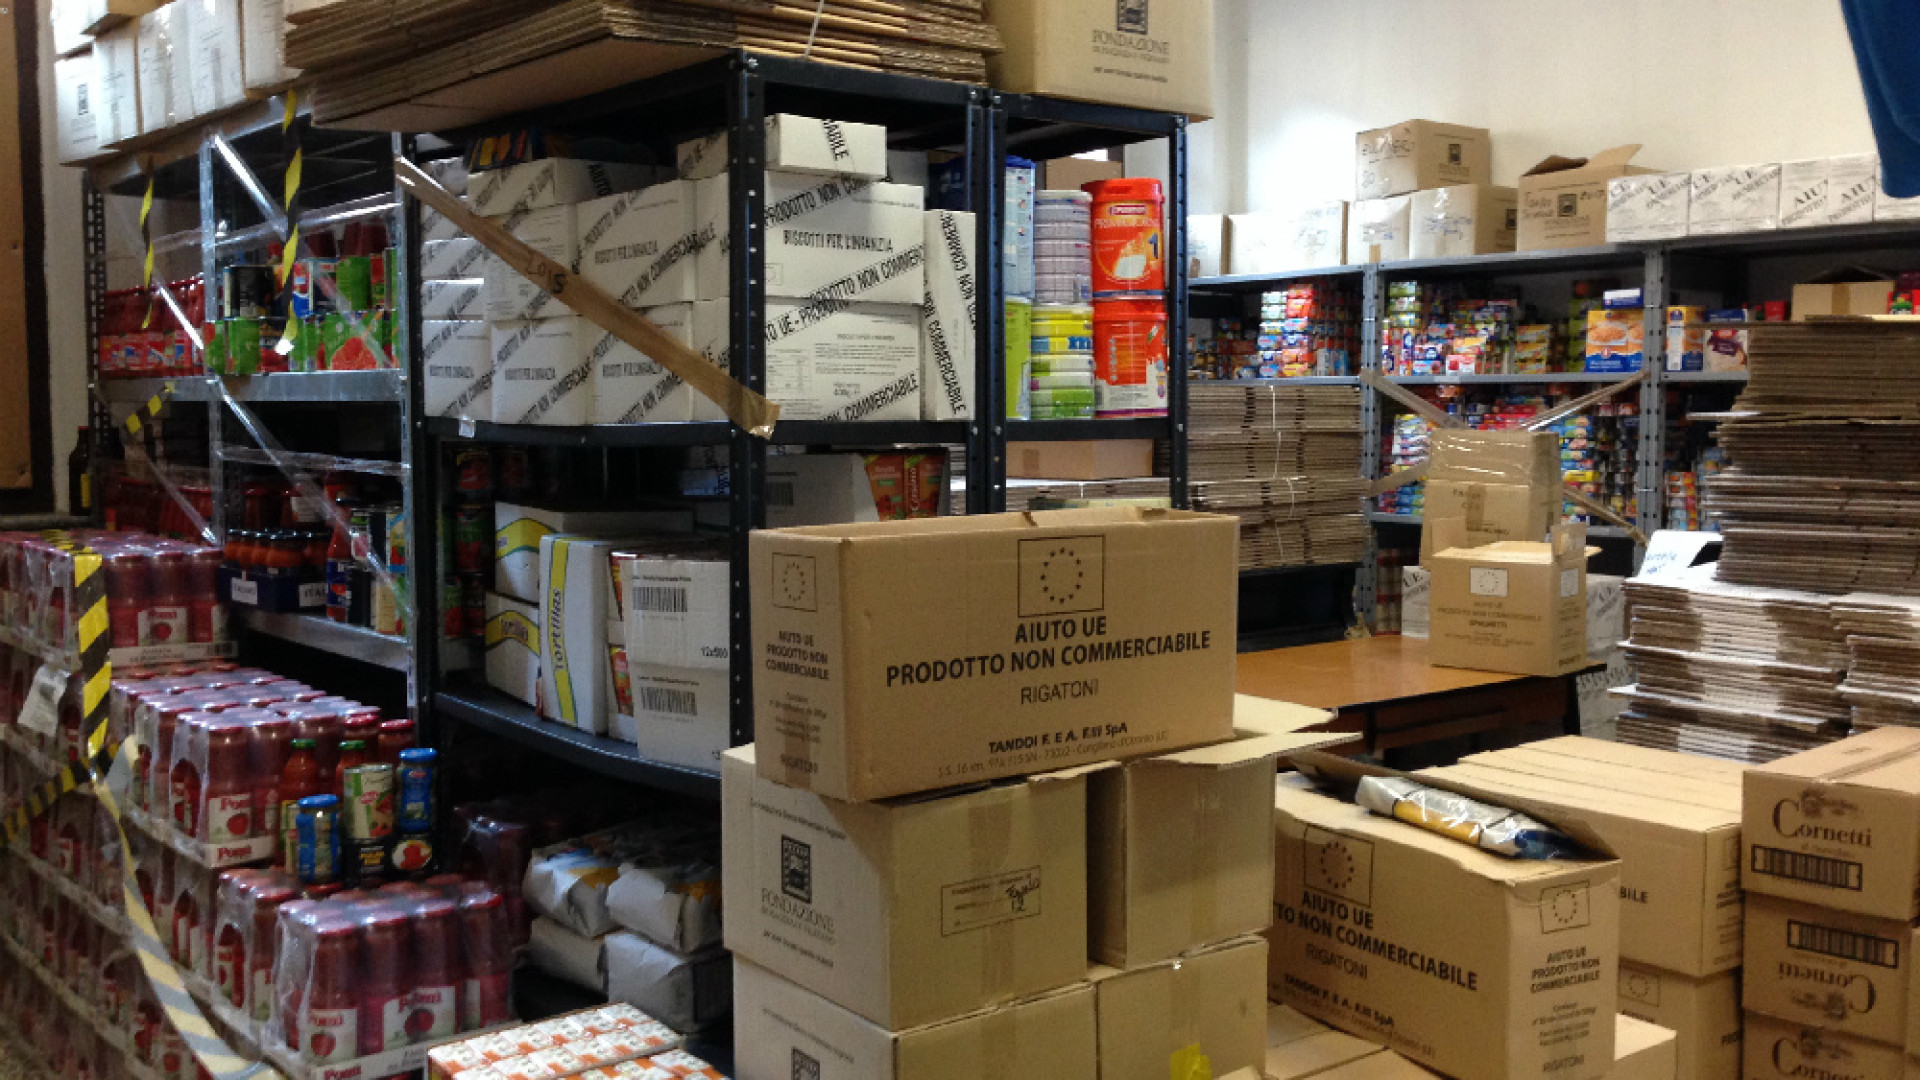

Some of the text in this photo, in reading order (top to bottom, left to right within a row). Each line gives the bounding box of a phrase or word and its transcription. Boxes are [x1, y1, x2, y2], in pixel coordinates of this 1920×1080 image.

[817, 181, 843, 205] NON
[783, 229, 825, 249] BISCOTTI
[826, 233, 844, 250] PER
[856, 267, 880, 291] NON
[844, 373, 919, 420] COMMERCIABILE
[1015, 616, 1107, 643] AIUTO UE
[766, 643, 829, 664] PRODOTTO NON
[886, 630, 1212, 687] PRODOTTO NON COMMERCIABILE
[765, 659, 830, 681] COMMERCIABILE
[1020, 679, 1099, 705] RIGATONI
[988, 736, 1038, 754] TANDOI
[1105, 722, 1128, 738] SpA
[1771, 798, 1873, 848] Cornetti
[760, 887, 836, 935] FONDAZIONE
[1301, 890, 1374, 930] AIUTO UE
[1297, 911, 1332, 938] NON
[1336, 925, 1478, 991] COMMERCIABILE
[1305, 943, 1368, 980] RIGATONI
[1531, 961, 1579, 981] PRODOTTO
[1778, 962, 1877, 1014] Cornetti
